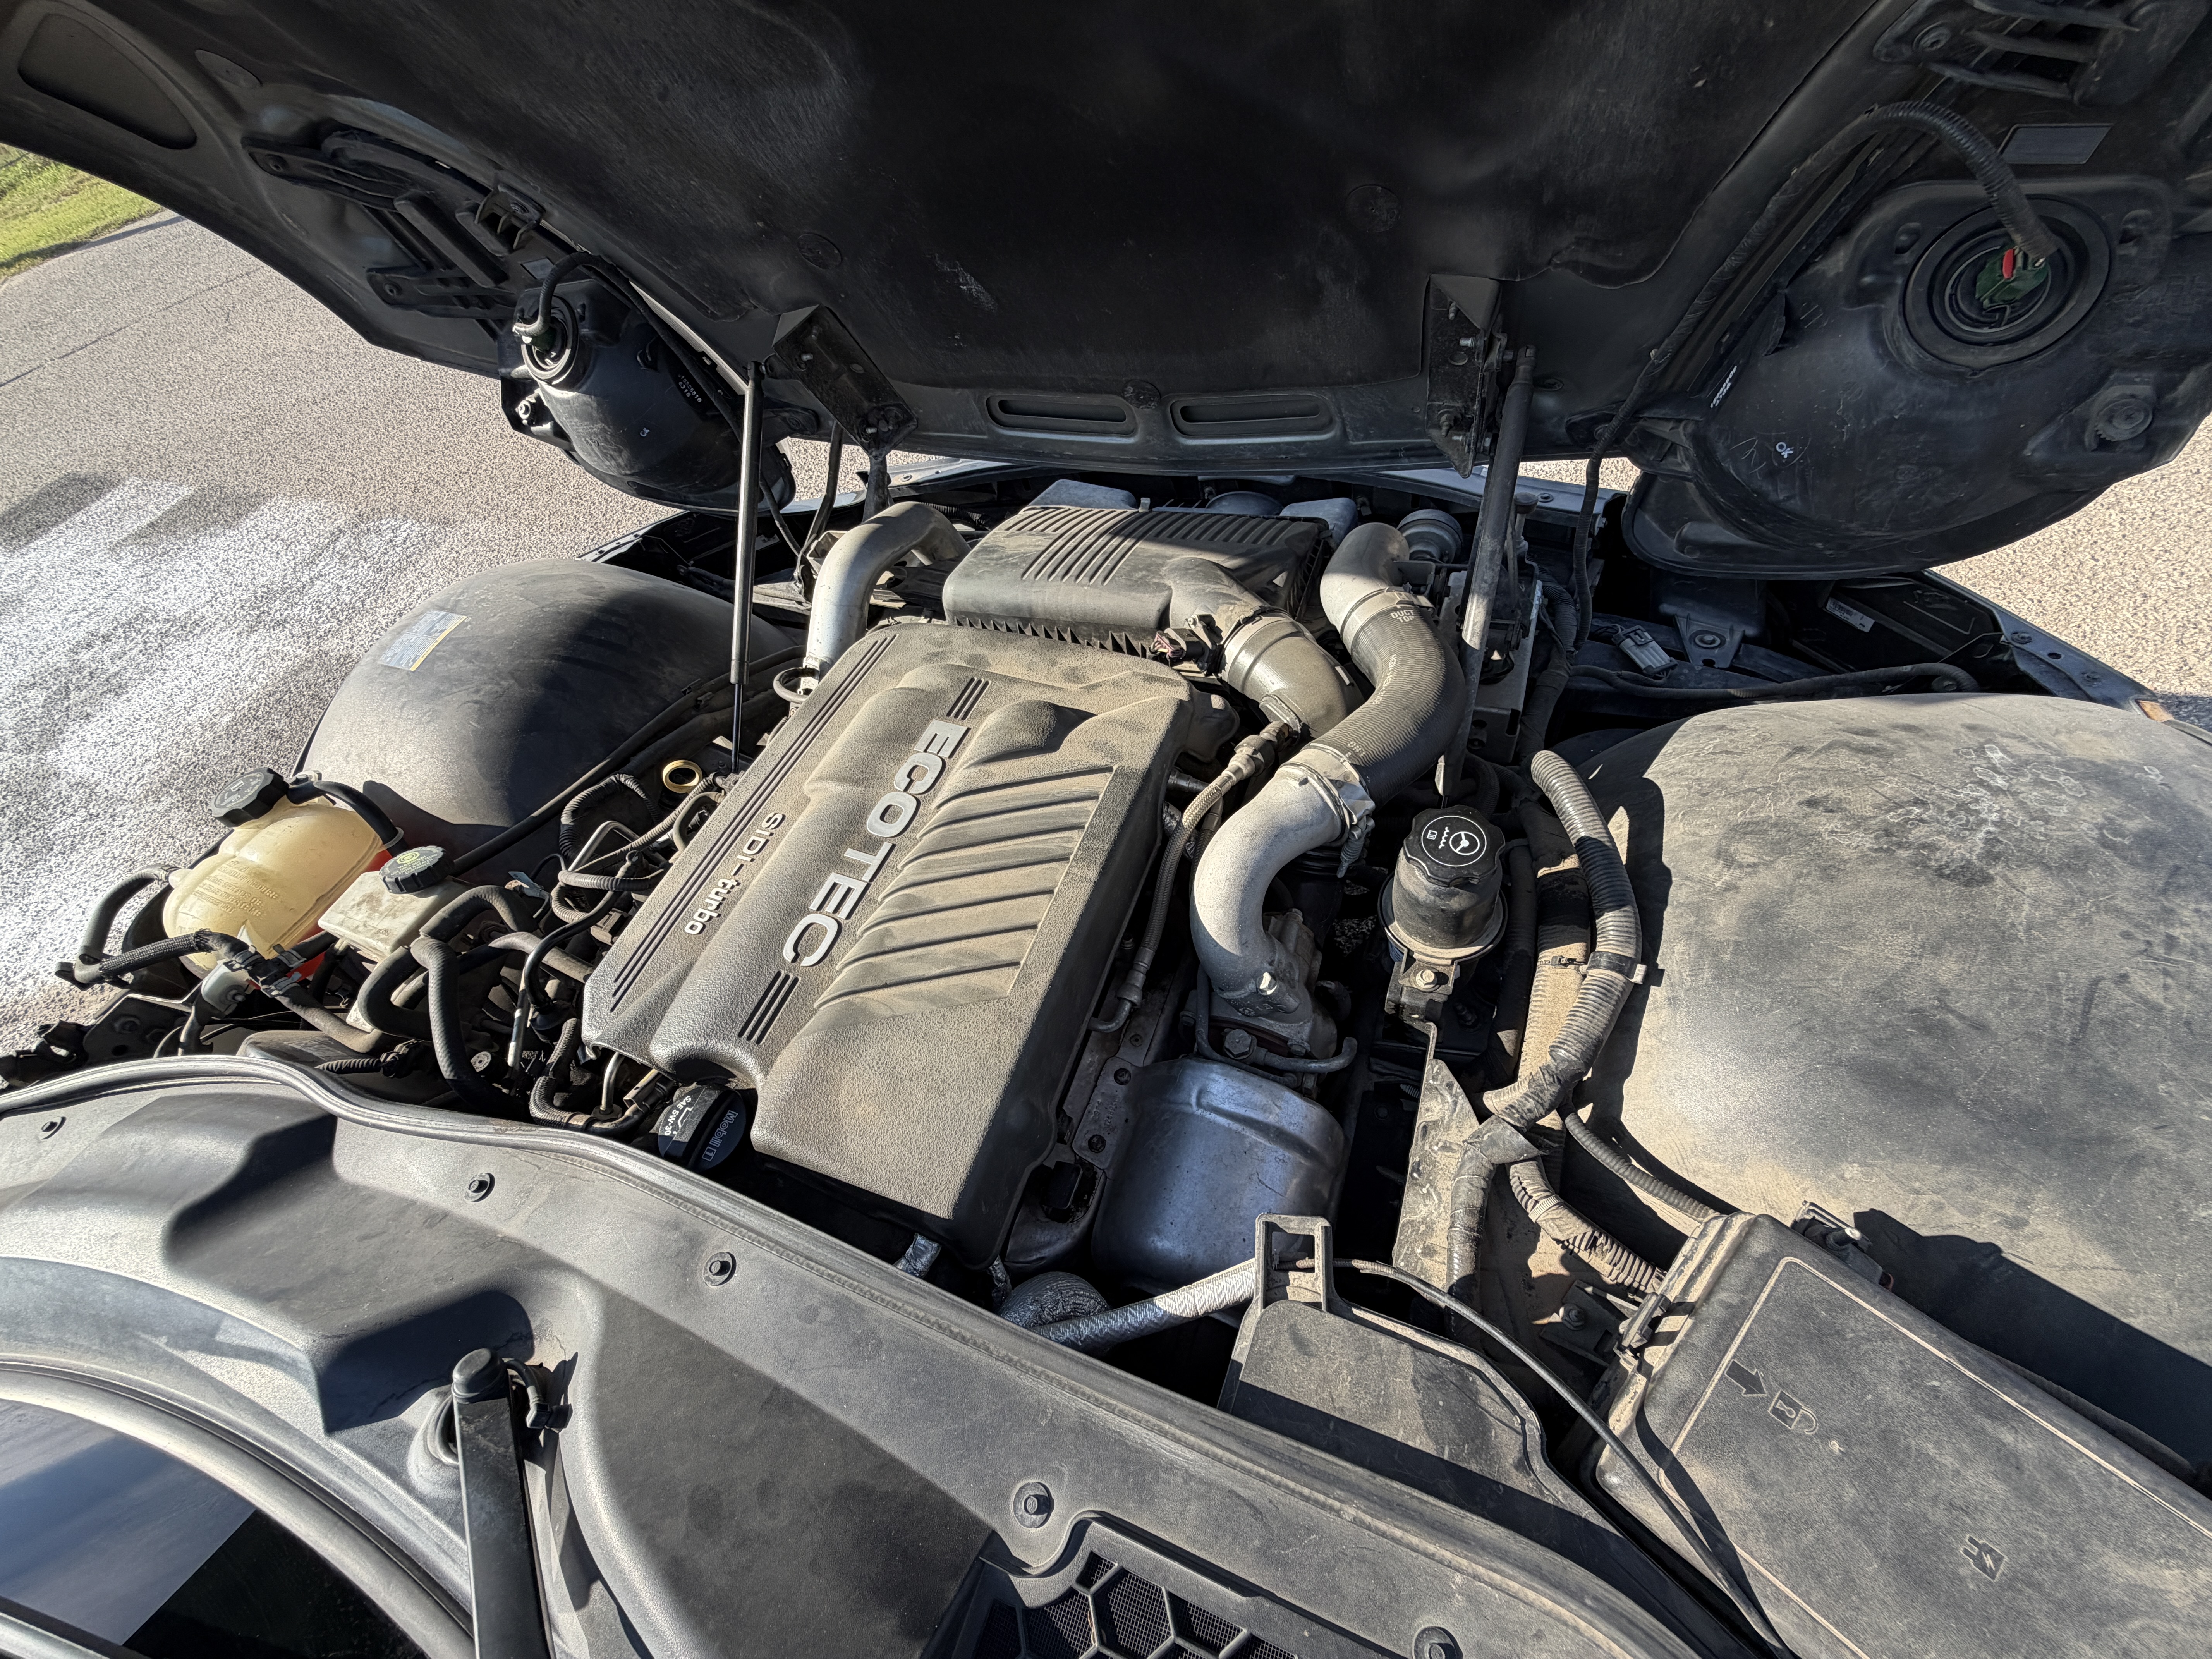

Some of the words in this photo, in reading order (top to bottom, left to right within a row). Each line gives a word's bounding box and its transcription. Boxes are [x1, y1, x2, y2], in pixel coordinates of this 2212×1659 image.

[1776, 442, 1794, 459] OK
[1391, 609, 1414, 619] DUCT
[783, 720, 969, 967] ECOTEC
[677, 1096, 692, 1110] SAE
[664, 1110, 680, 1136] 5W-30
[709, 1110, 739, 1148] Mobil
[702, 1146, 717, 1161] 1
